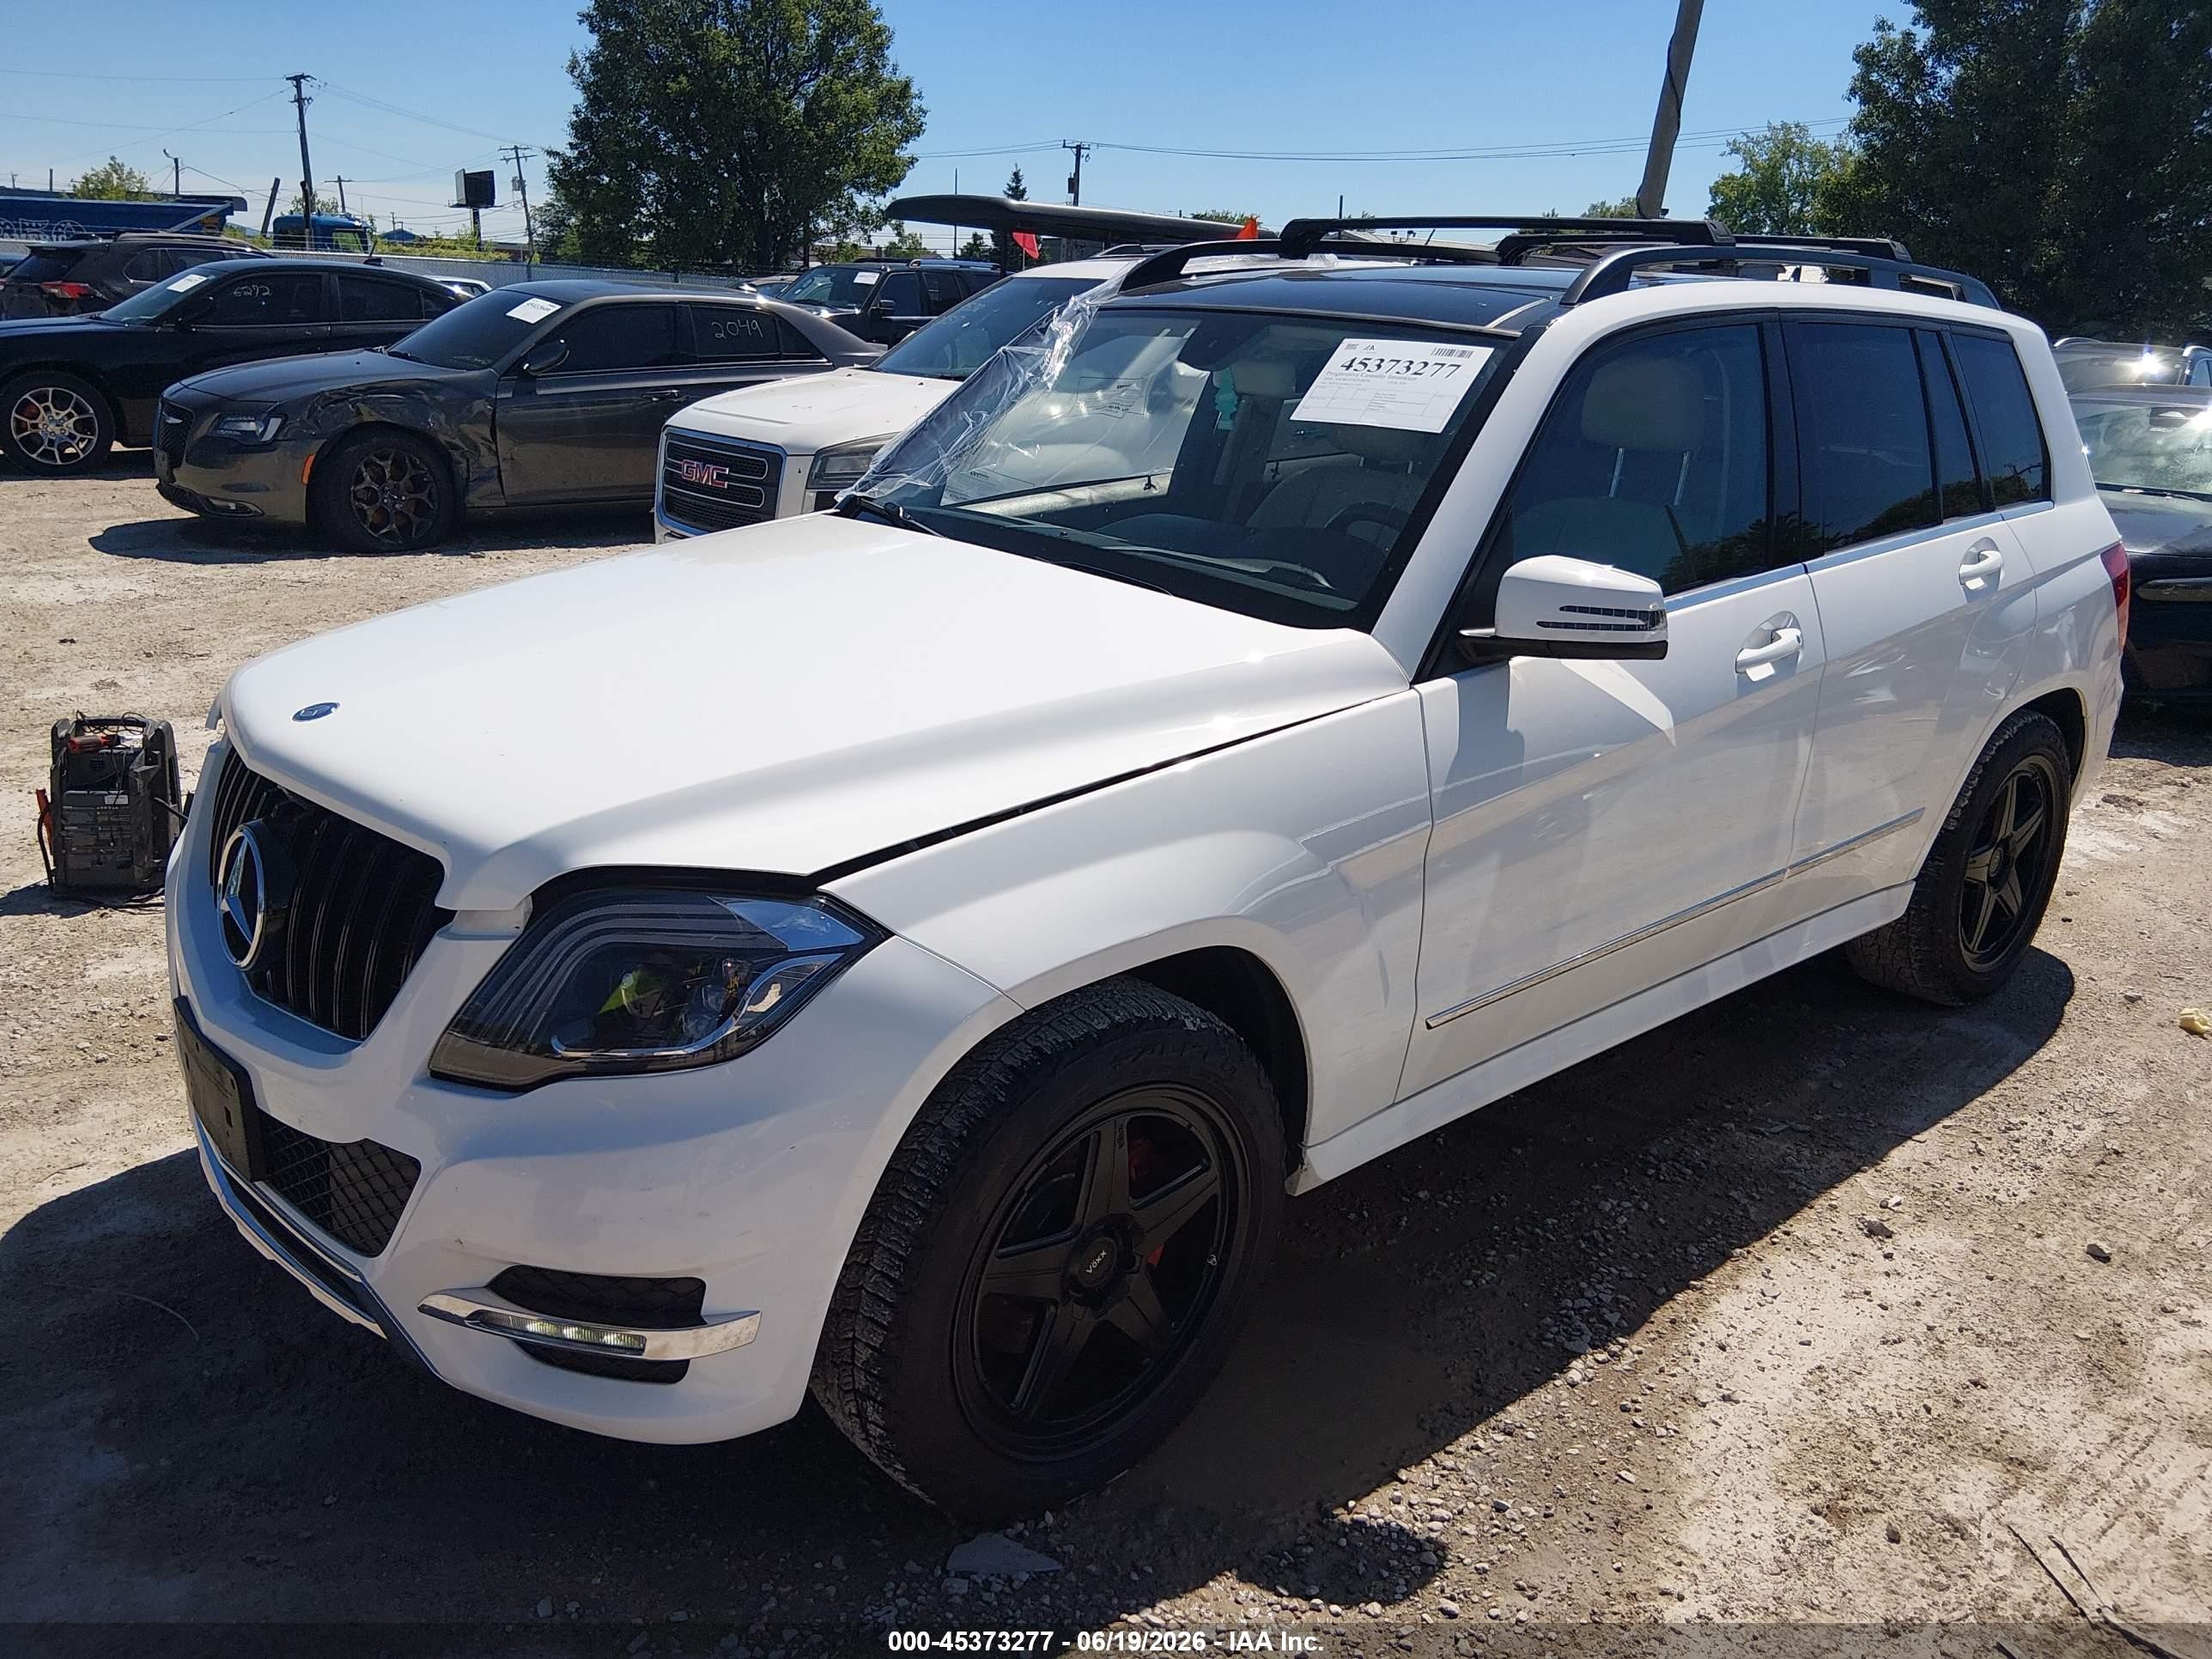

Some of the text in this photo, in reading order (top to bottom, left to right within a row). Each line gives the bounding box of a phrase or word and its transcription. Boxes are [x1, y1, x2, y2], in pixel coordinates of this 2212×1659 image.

[233, 284, 272, 298] 6272
[710, 319, 763, 340] 2049
[1340, 356, 1463, 380] 45373277
[681, 459, 730, 489] GMC
